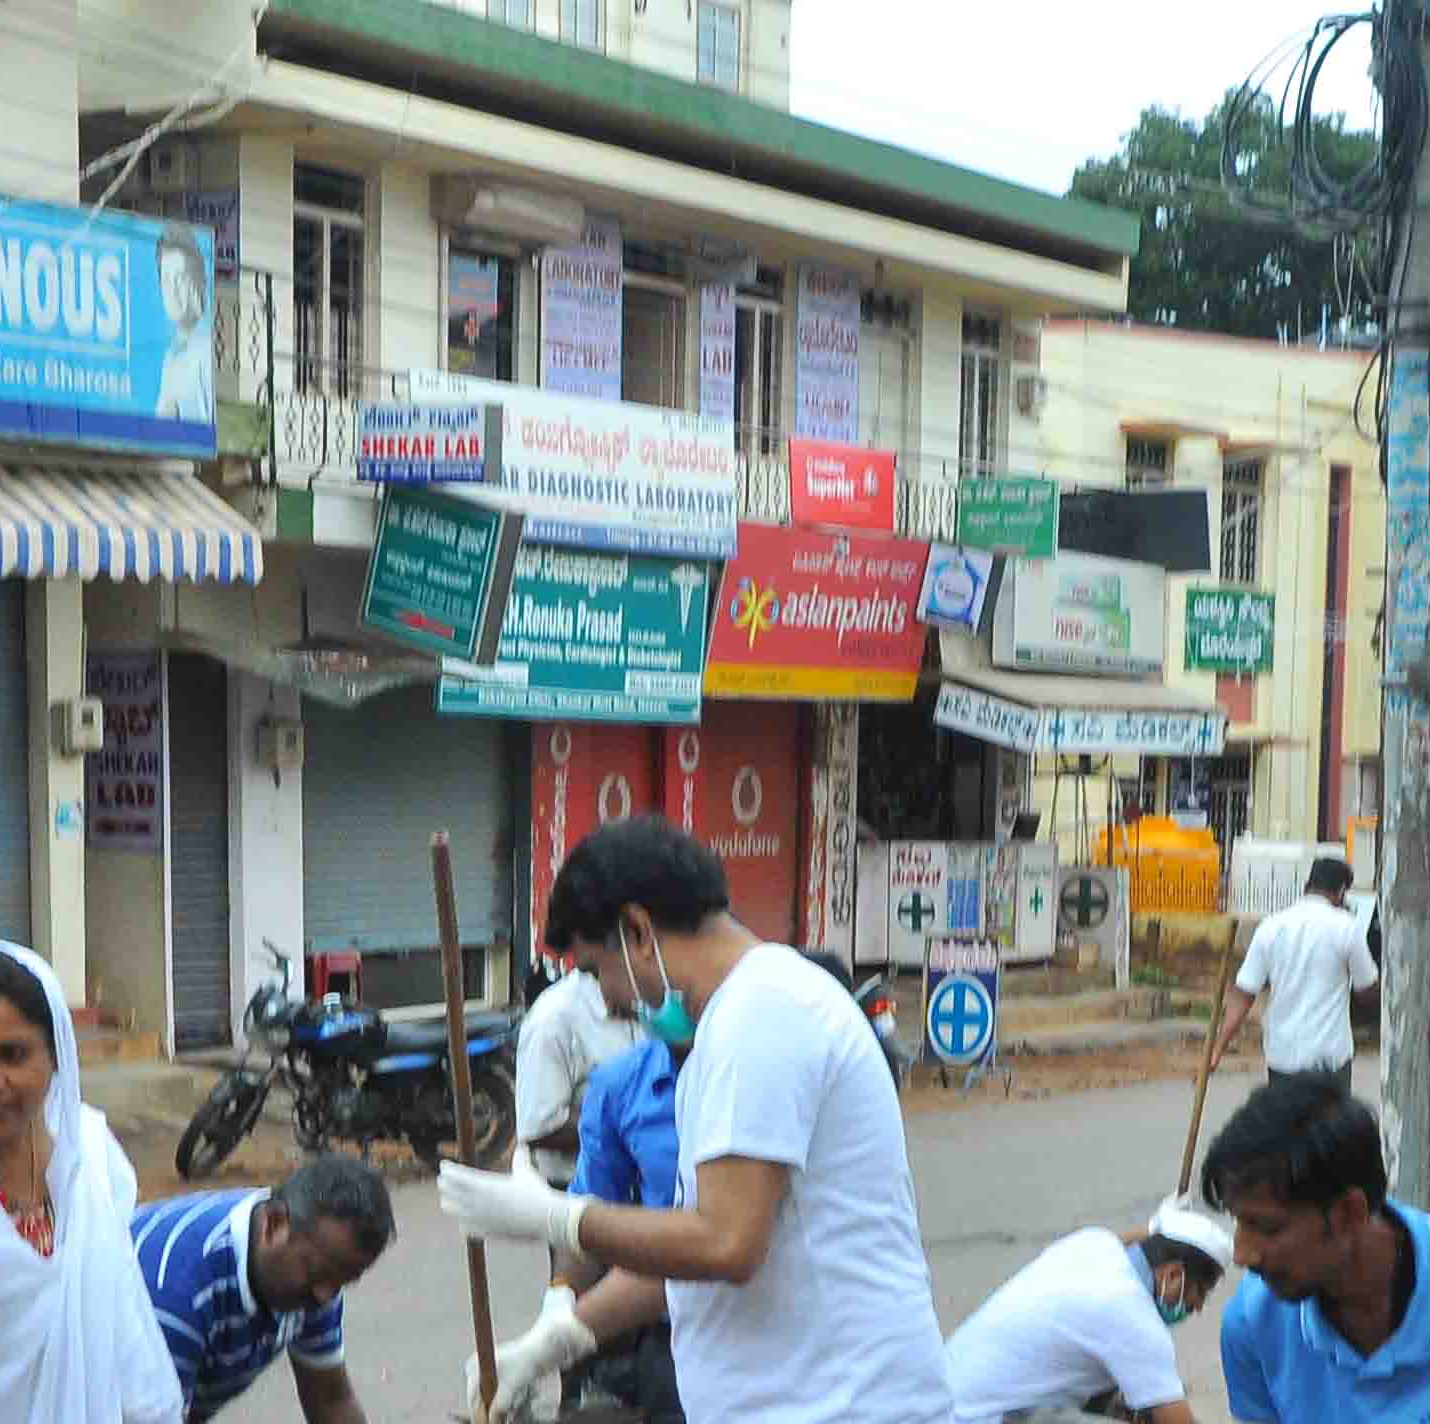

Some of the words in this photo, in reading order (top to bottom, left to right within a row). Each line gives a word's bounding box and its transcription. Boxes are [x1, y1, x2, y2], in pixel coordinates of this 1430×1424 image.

[444, 434, 480, 461] LAB
[527, 468, 630, 503] DIAGNOSTIC
[635, 484, 735, 516] LABORATORY
[781, 581, 908, 649] asianpaints
